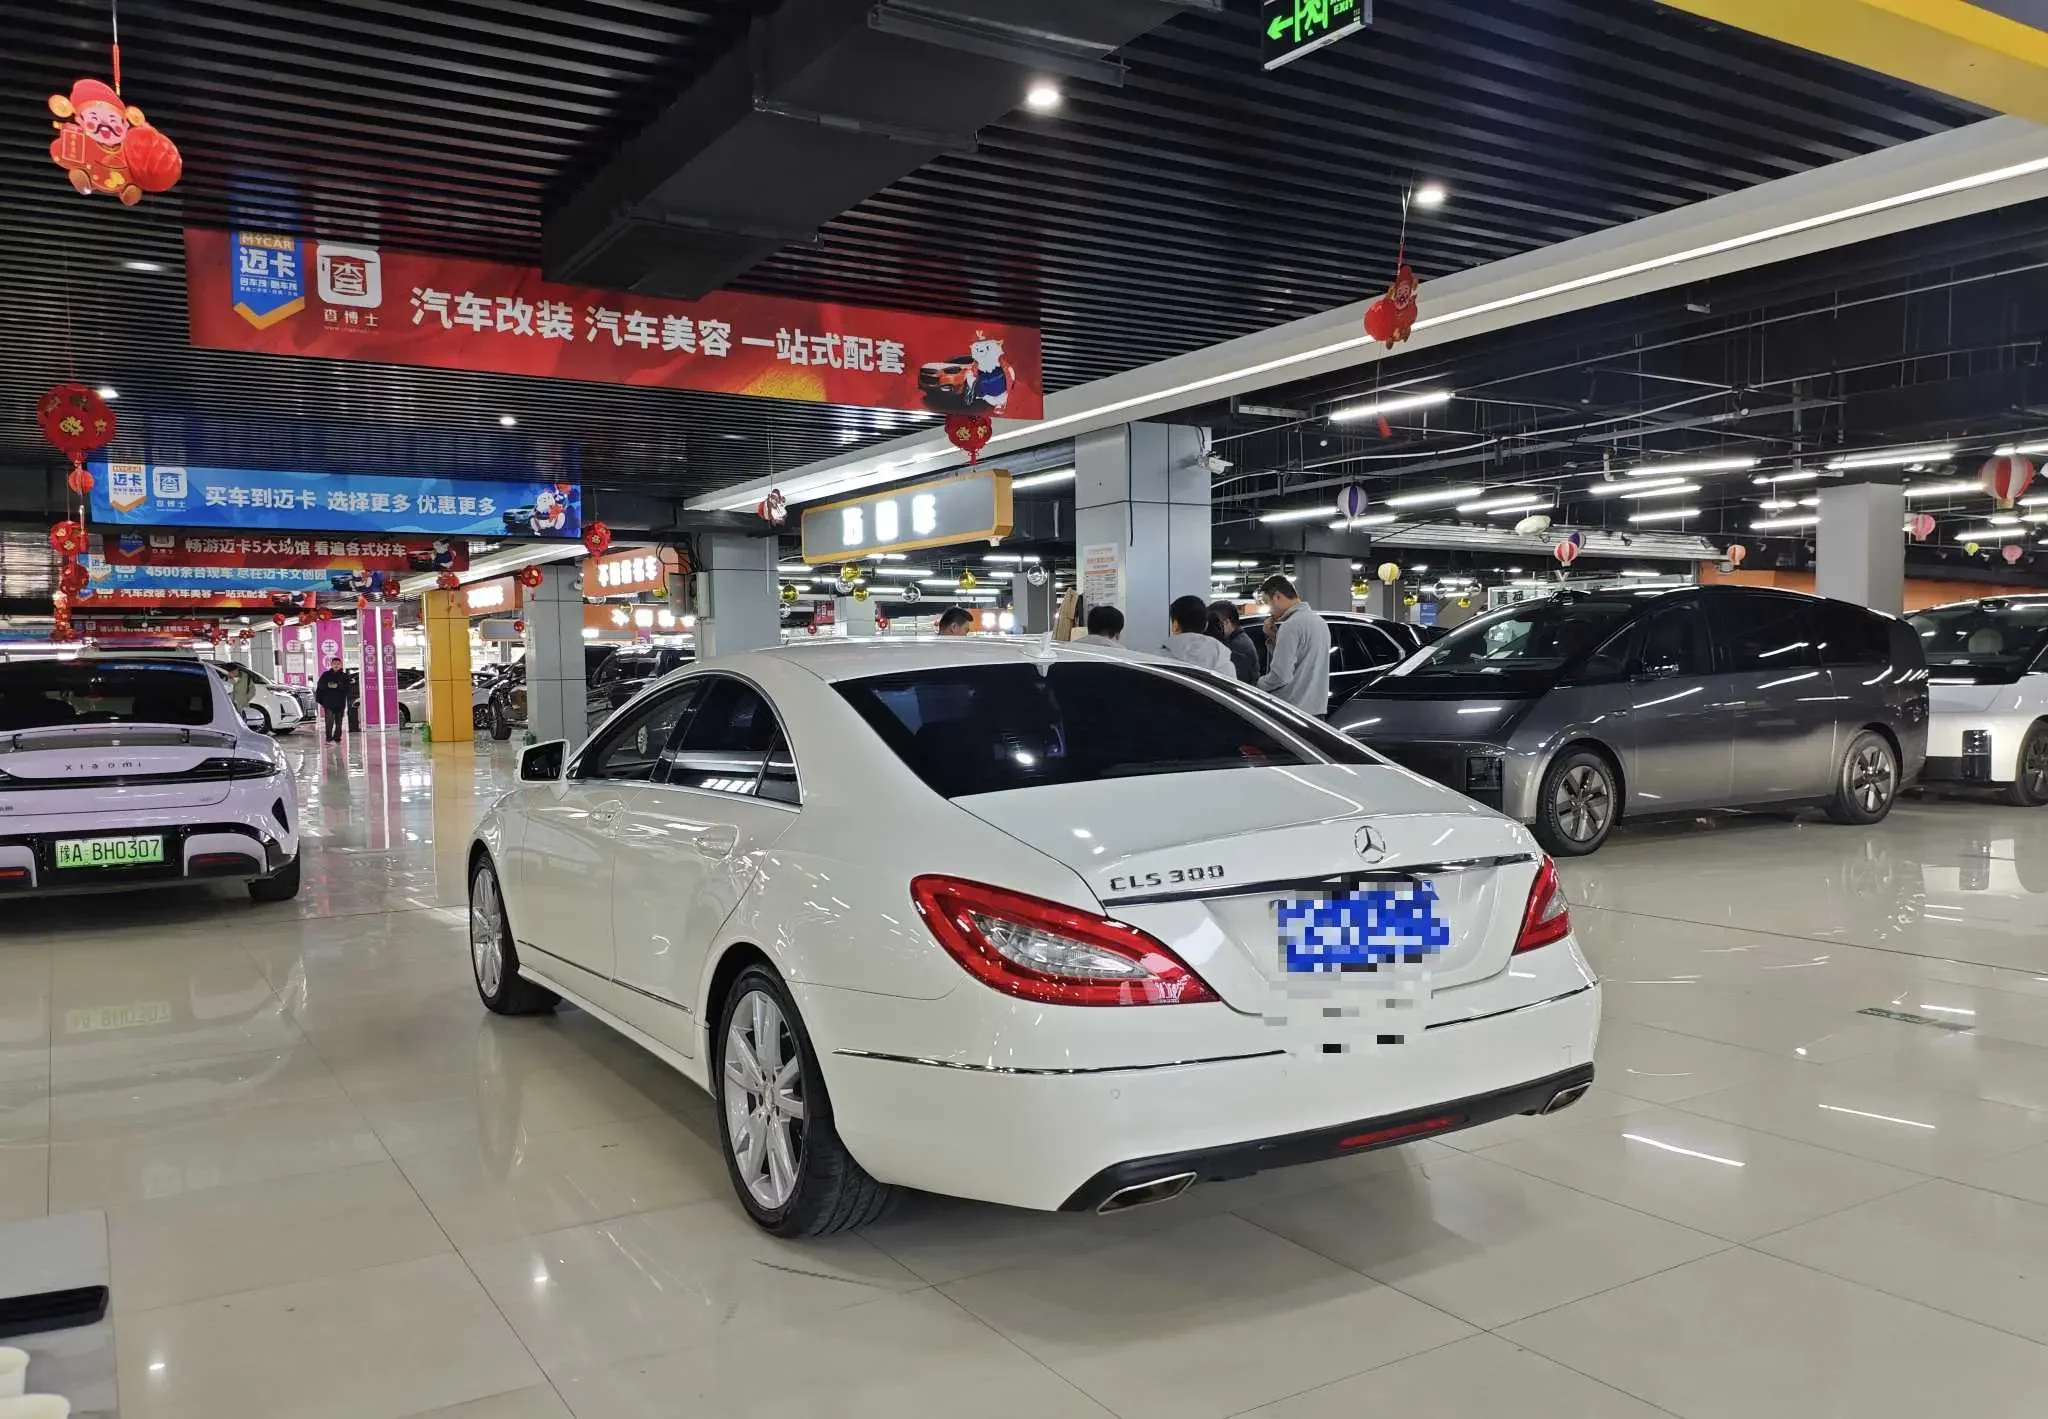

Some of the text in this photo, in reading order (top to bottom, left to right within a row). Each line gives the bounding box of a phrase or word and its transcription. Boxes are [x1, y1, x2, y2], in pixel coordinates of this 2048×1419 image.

[242, 235, 292, 249] MYCAR
[240, 247, 295, 278] 迈卡
[324, 308, 379, 327] 查博士
[410, 287, 905, 375] 汽车改装 汽车美容 一站式配套
[113, 473, 142, 487] 迈卡
[205, 486, 497, 517] 买车到迈卡 选择更多 优惠更多
[185, 538, 407, 558] 畅游迈卡5大场馆 看遍各式好车
[65, 761, 142, 772] xiaomi
[92, 839, 160, 861] BH0307
[1110, 864, 1225, 892] CLS 300
